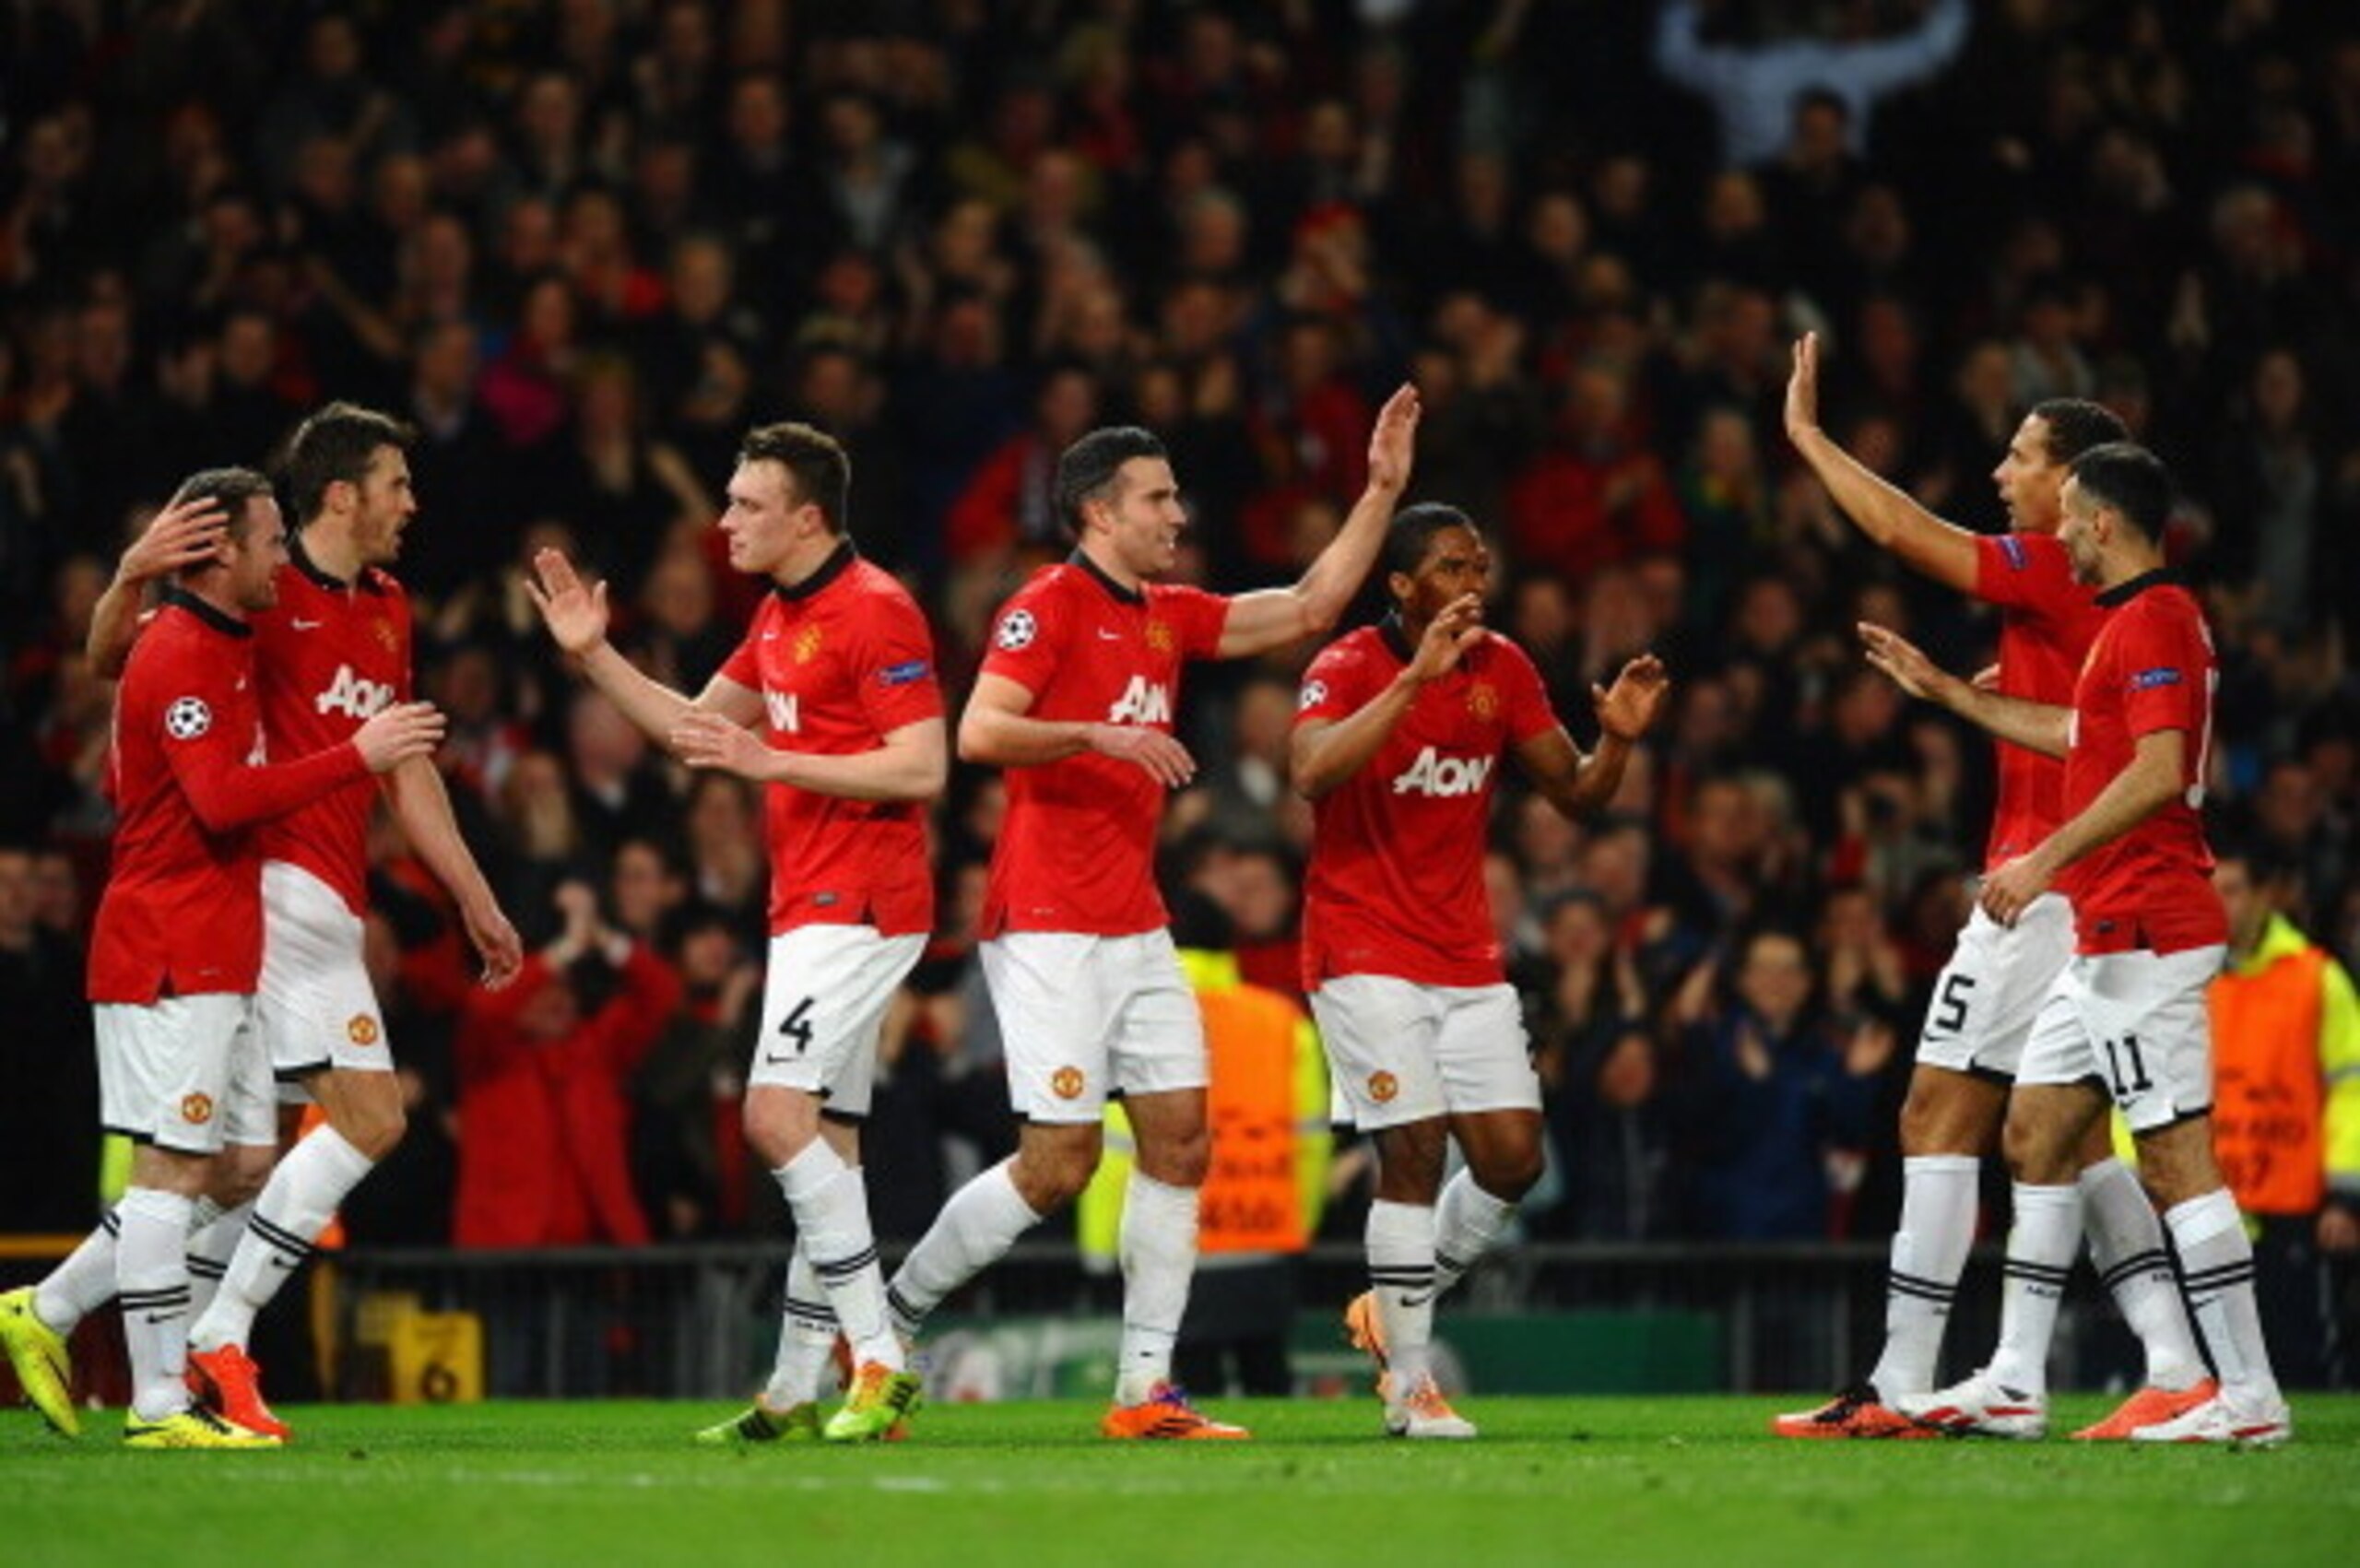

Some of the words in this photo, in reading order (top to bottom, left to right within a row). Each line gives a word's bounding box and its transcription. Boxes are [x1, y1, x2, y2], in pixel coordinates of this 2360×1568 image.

[1392, 745, 1493, 797] AON
[779, 996, 814, 1055] 4
[1935, 973, 1975, 1033] 5
[2105, 1034, 2154, 1096] 11
